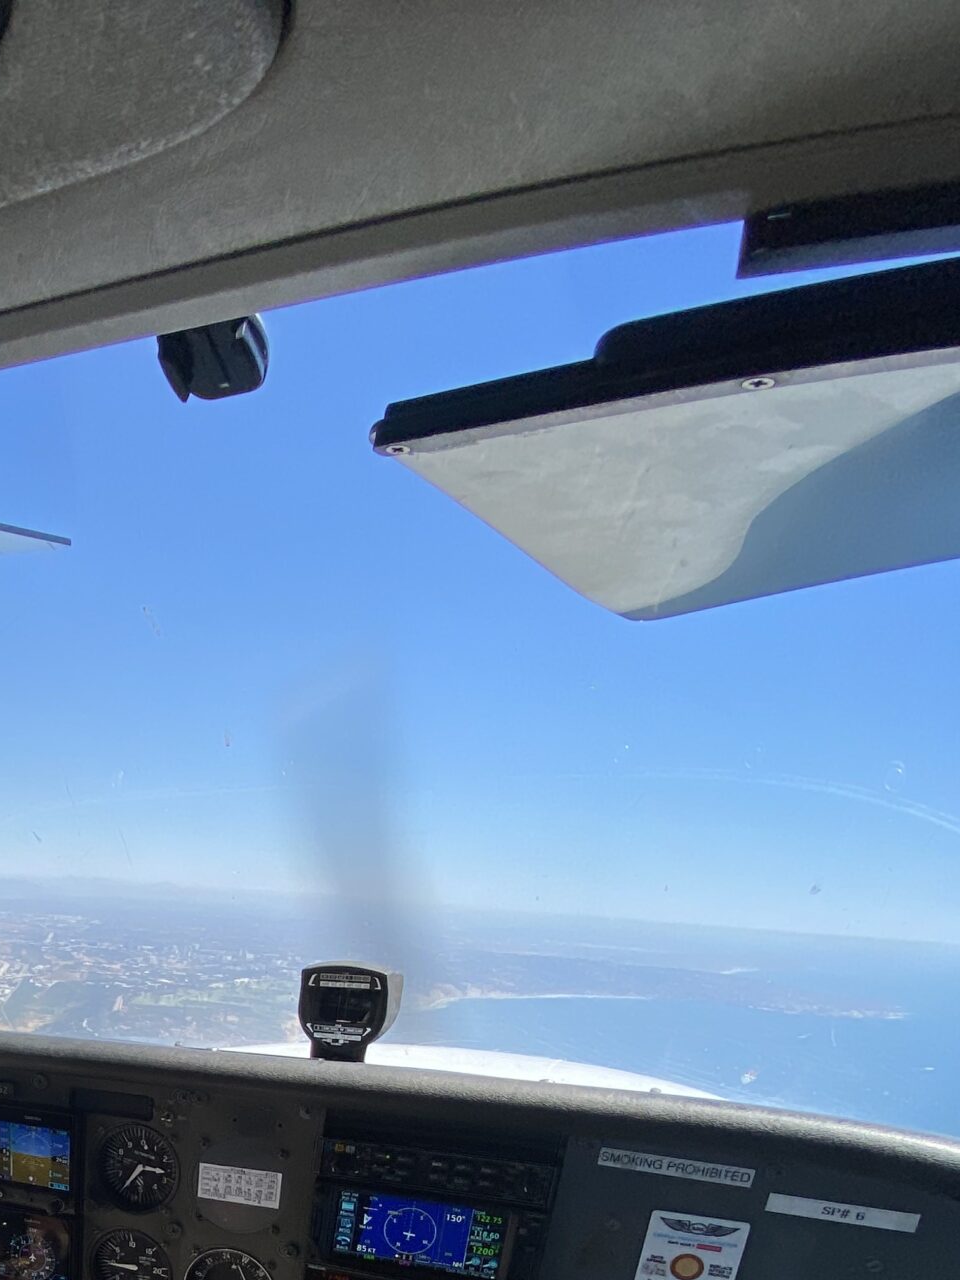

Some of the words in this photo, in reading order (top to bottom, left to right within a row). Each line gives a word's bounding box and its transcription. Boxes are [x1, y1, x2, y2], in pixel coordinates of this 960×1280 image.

[600, 1151, 663, 1171] SMOKING
[667, 1161, 751, 1184] PROHIBITED
[446, 1213, 466, 1224] 150°
[476, 1215, 503, 1225] 122.75
[356, 1244, 367, 1252] 85
[472, 1246, 495, 1256] 1200
[152, 1266, 162, 1275] 20
